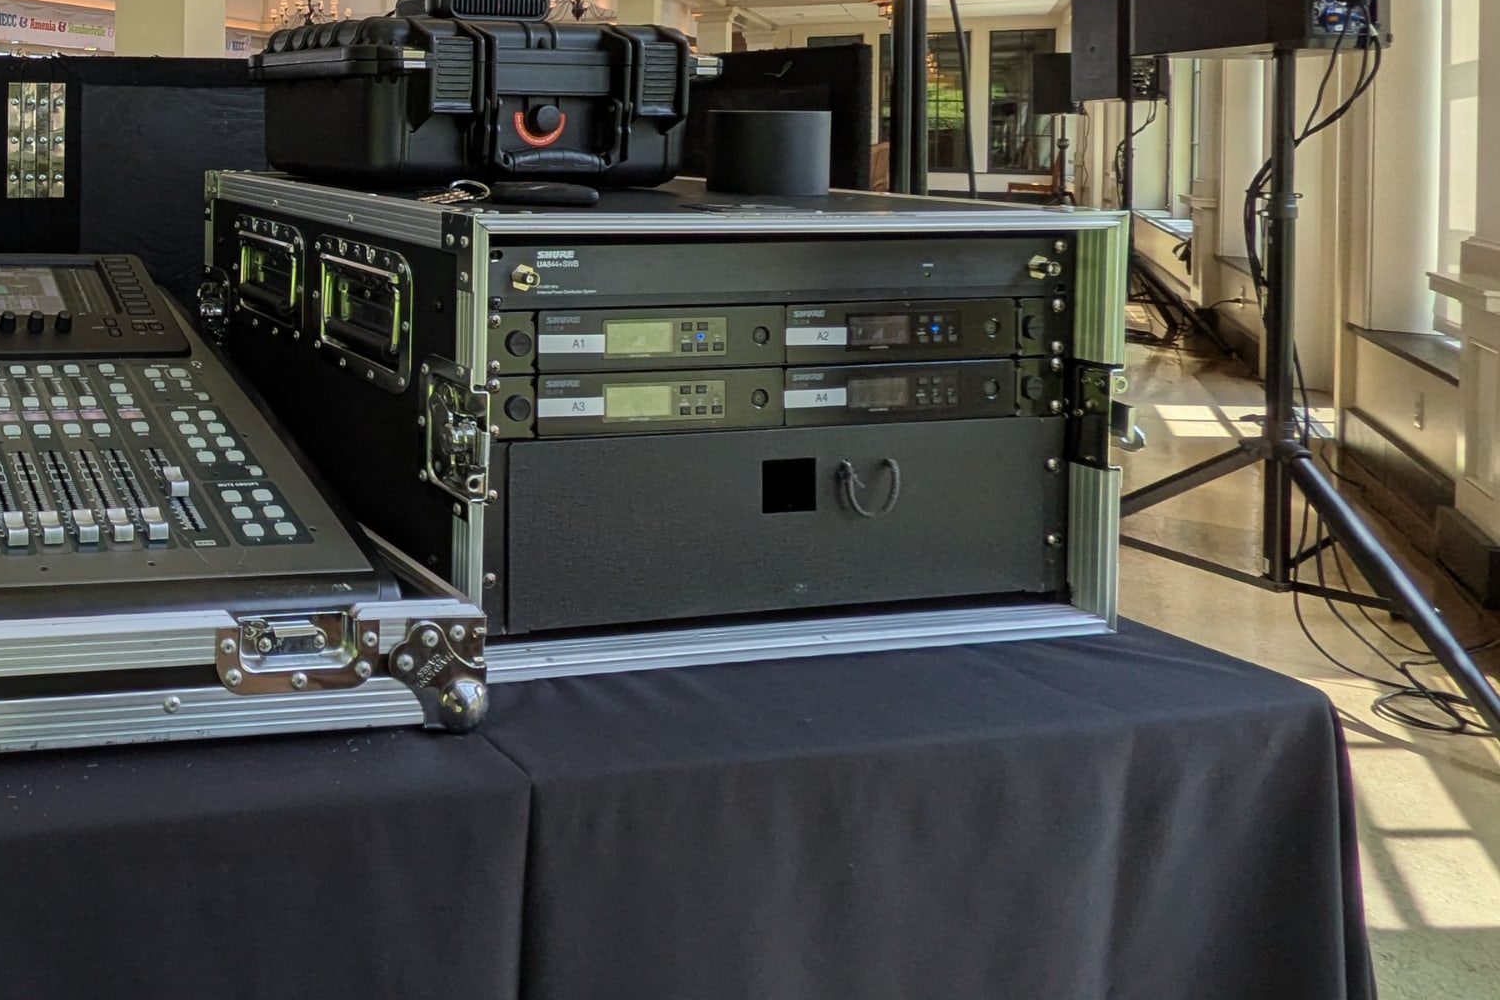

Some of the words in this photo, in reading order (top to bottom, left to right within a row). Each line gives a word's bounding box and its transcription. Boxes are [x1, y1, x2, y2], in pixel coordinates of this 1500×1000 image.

[19, 16, 28, 29] &
[30, 18, 57, 32] Amenia
[58, 21, 67, 33] &
[536, 250, 575, 259] SHURE
[817, 332, 829, 341] A2
[572, 338, 585, 348] A1
[815, 393, 828, 402] A4
[572, 402, 585, 411] A3
